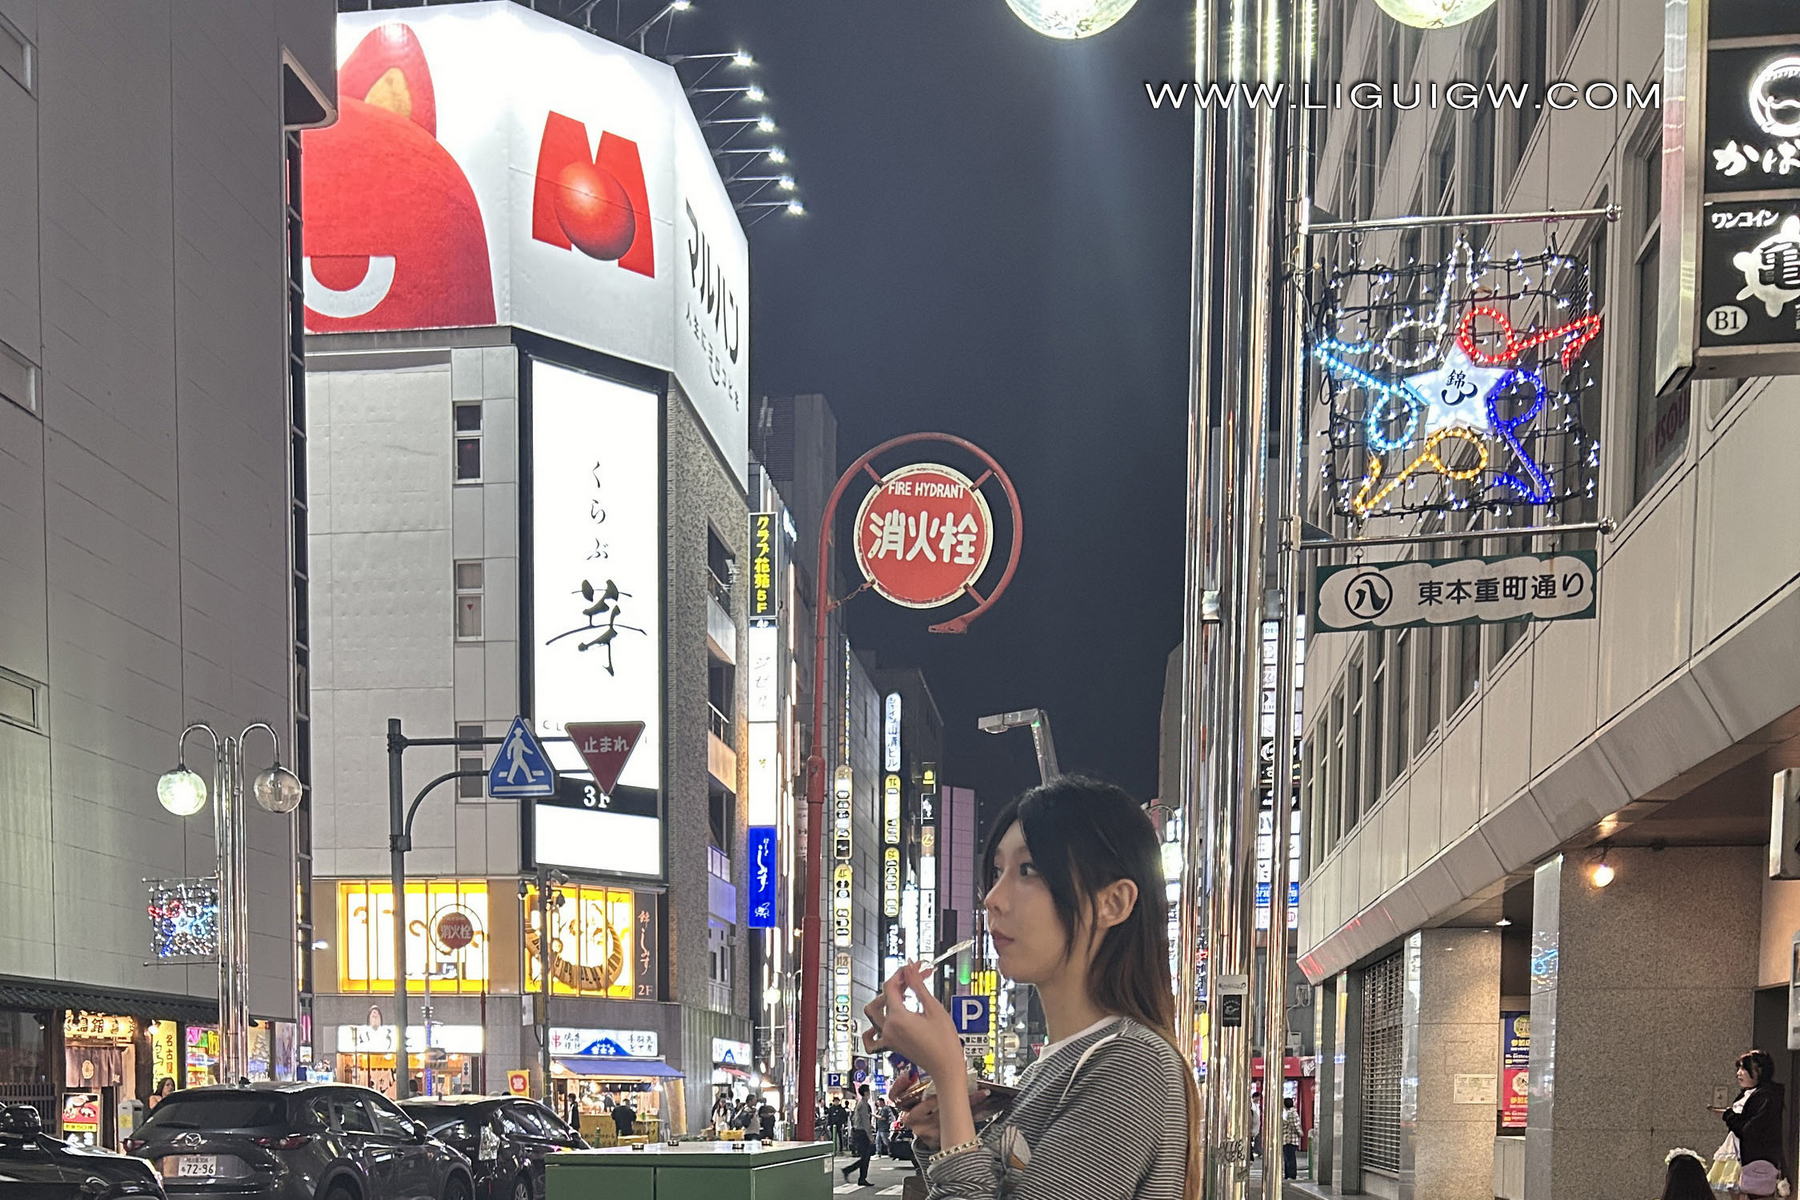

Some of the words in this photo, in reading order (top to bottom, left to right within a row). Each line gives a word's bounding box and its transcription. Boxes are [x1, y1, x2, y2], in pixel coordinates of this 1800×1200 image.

[1711, 208, 1780, 230] ワンコイン
[685, 196, 739, 366] マルハン
[1713, 310, 1741, 331] B1
[1446, 369, 1467, 390] 錦
[888, 482, 912, 496] FIRE
[915, 483, 965, 499] HYDRANT
[586, 460, 609, 562] くらぶ
[867, 509, 979, 565] 消火栓
[1417, 571, 1586, 606] 東本重町通り
[583, 735, 630, 753] 止まれ
[441, 924, 472, 939] 消火栓
[638, 984, 653, 996] 2F
[962, 999, 983, 1031] P
[831, 1074, 839, 1085] P
[186, 1163, 214, 1175] 72-96
